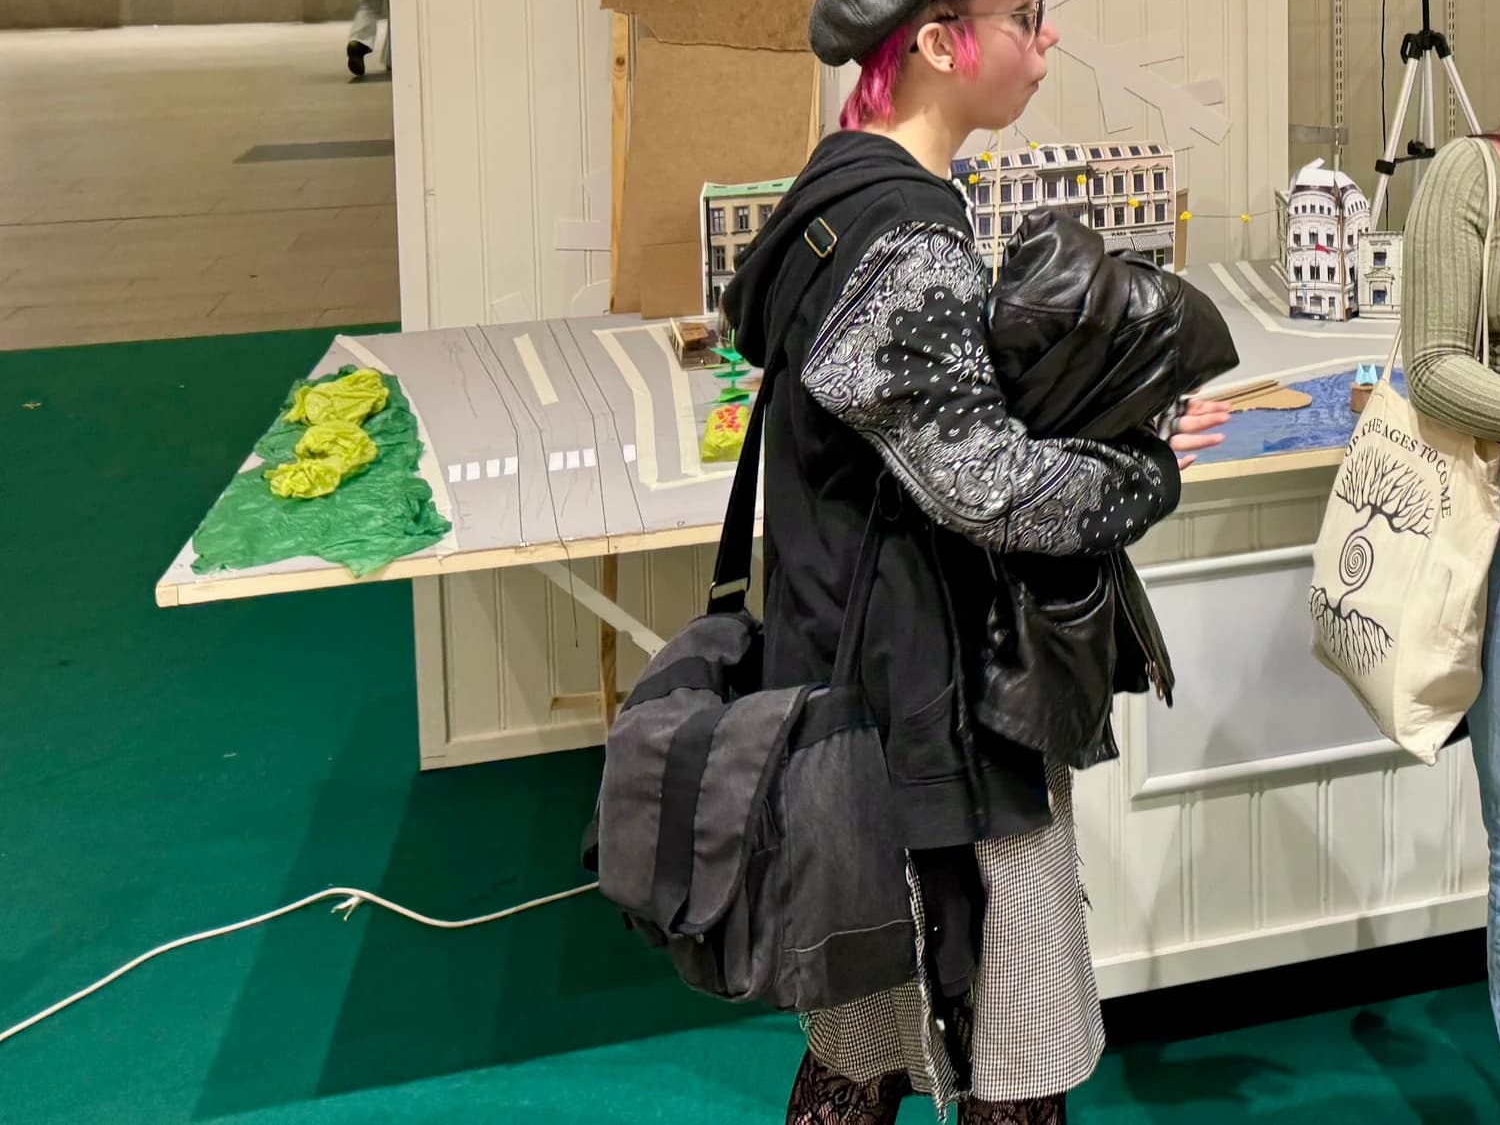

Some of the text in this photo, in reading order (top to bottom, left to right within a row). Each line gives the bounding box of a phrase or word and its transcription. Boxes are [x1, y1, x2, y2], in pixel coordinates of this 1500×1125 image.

[1361, 418, 1383, 438] THE
[1381, 423, 1419, 453] AGES
[1419, 443, 1439, 464] TO
[1435, 458, 1453, 520] COME
